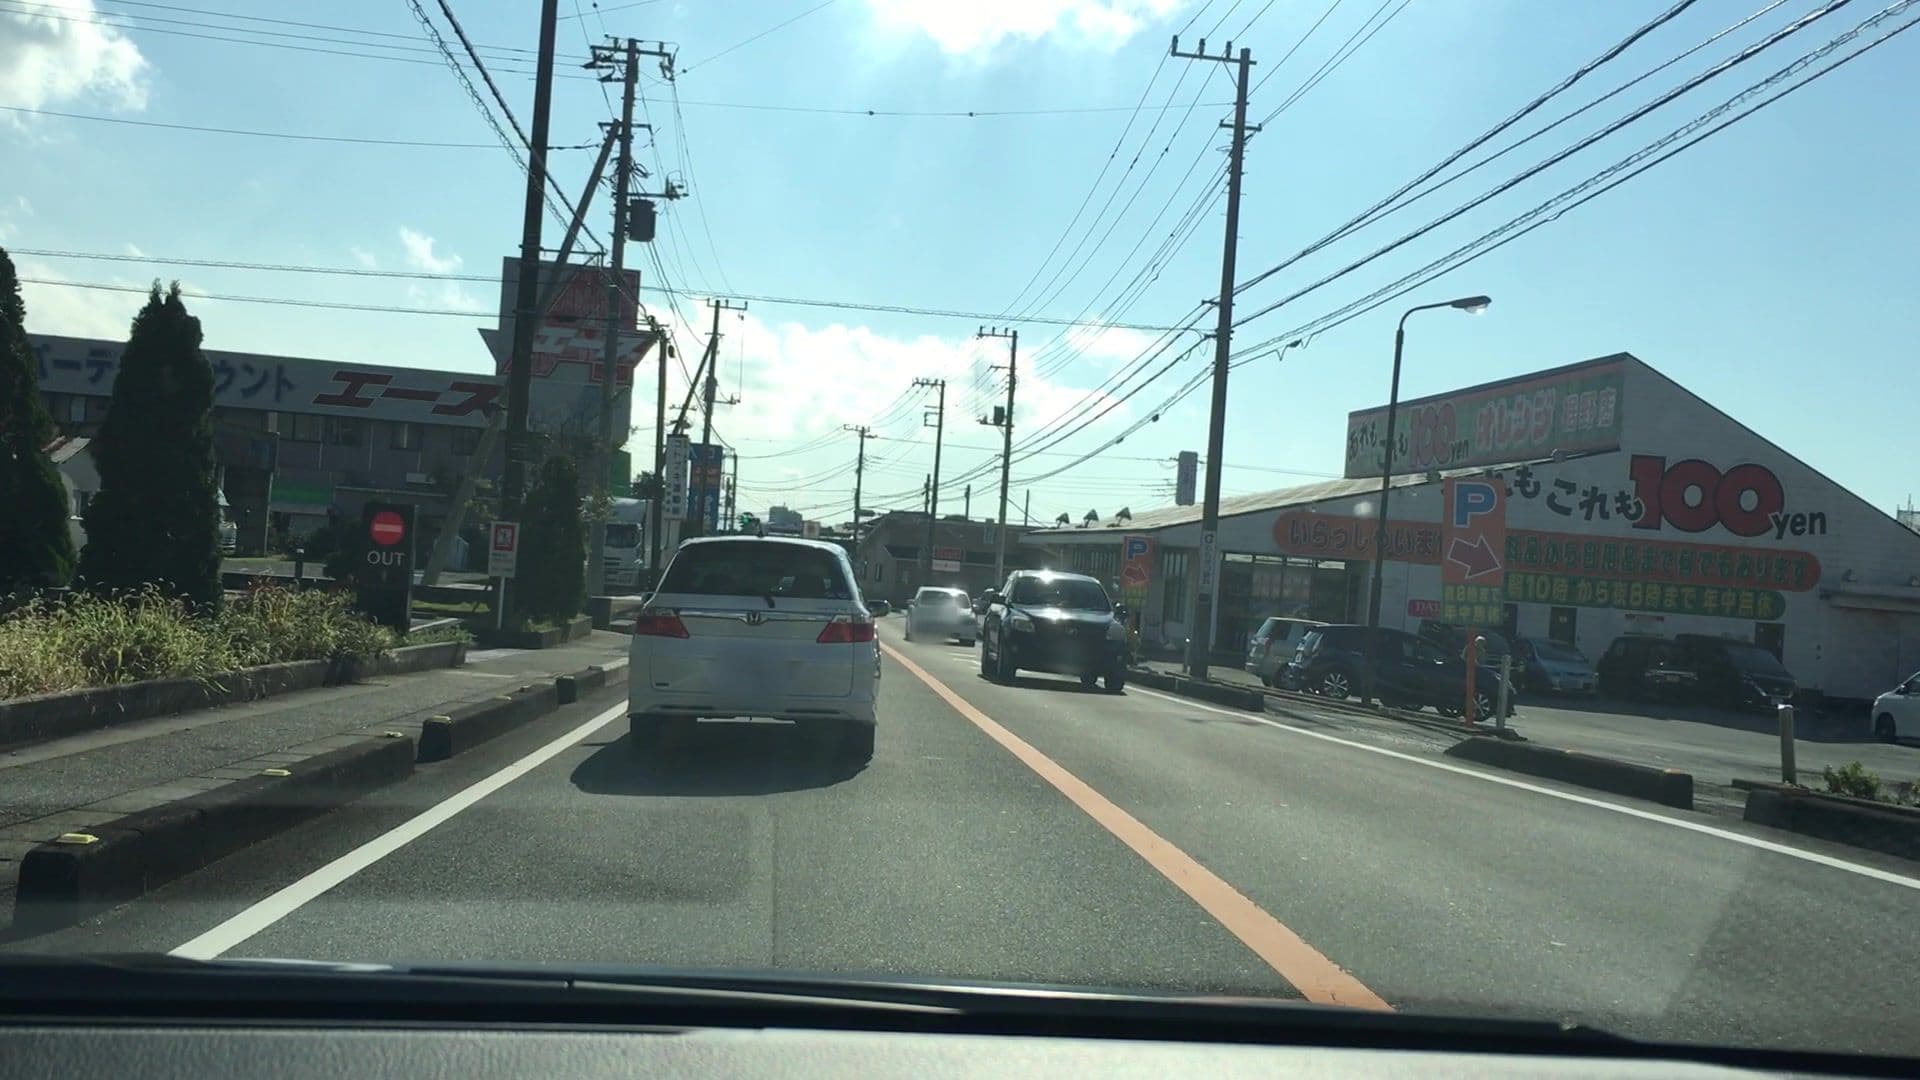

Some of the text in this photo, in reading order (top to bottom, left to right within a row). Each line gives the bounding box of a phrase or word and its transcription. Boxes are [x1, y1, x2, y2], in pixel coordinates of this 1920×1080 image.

[312, 371, 505, 417] エース
[1409, 399, 1457, 468] 100
[1450, 440, 1469, 464] yen
[1453, 483, 1496, 529] P
[1630, 454, 1785, 537] 100
[1771, 510, 1827, 539] yen
[367, 550, 405, 566] OUT
[1126, 537, 1149, 561] P
[1287, 519, 1442, 555] いらっしゃいま
